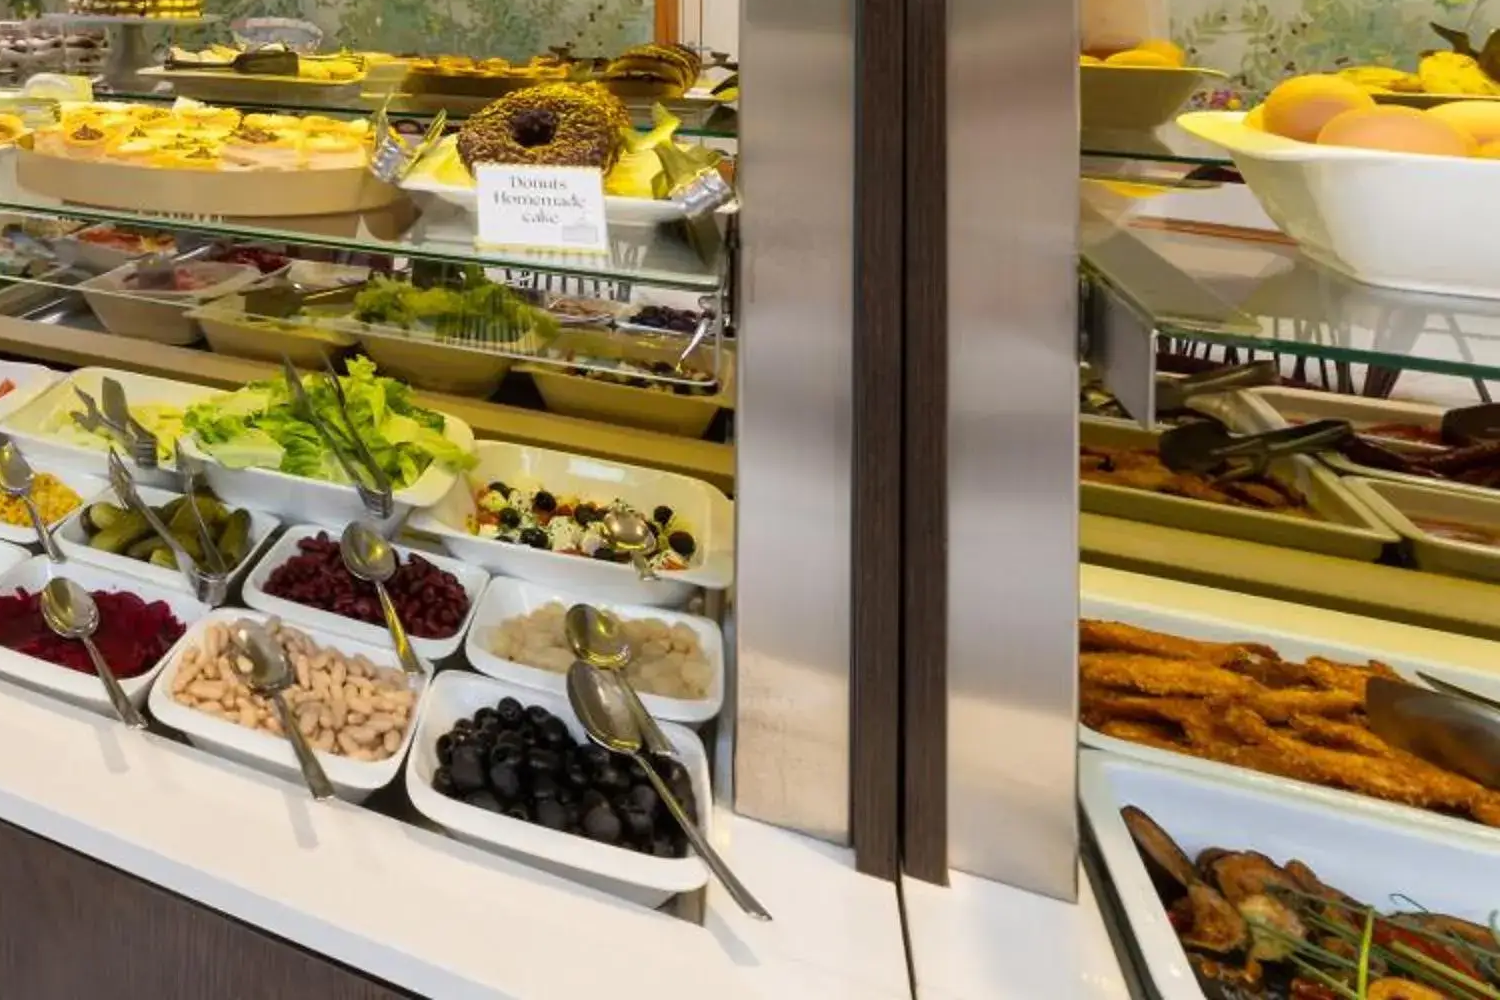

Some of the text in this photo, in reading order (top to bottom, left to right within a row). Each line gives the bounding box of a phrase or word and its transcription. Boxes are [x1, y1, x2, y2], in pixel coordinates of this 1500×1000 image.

[510, 175, 567, 190] Donuts
[494, 190, 586, 208] Homemade
[521, 208, 560, 224] cake
